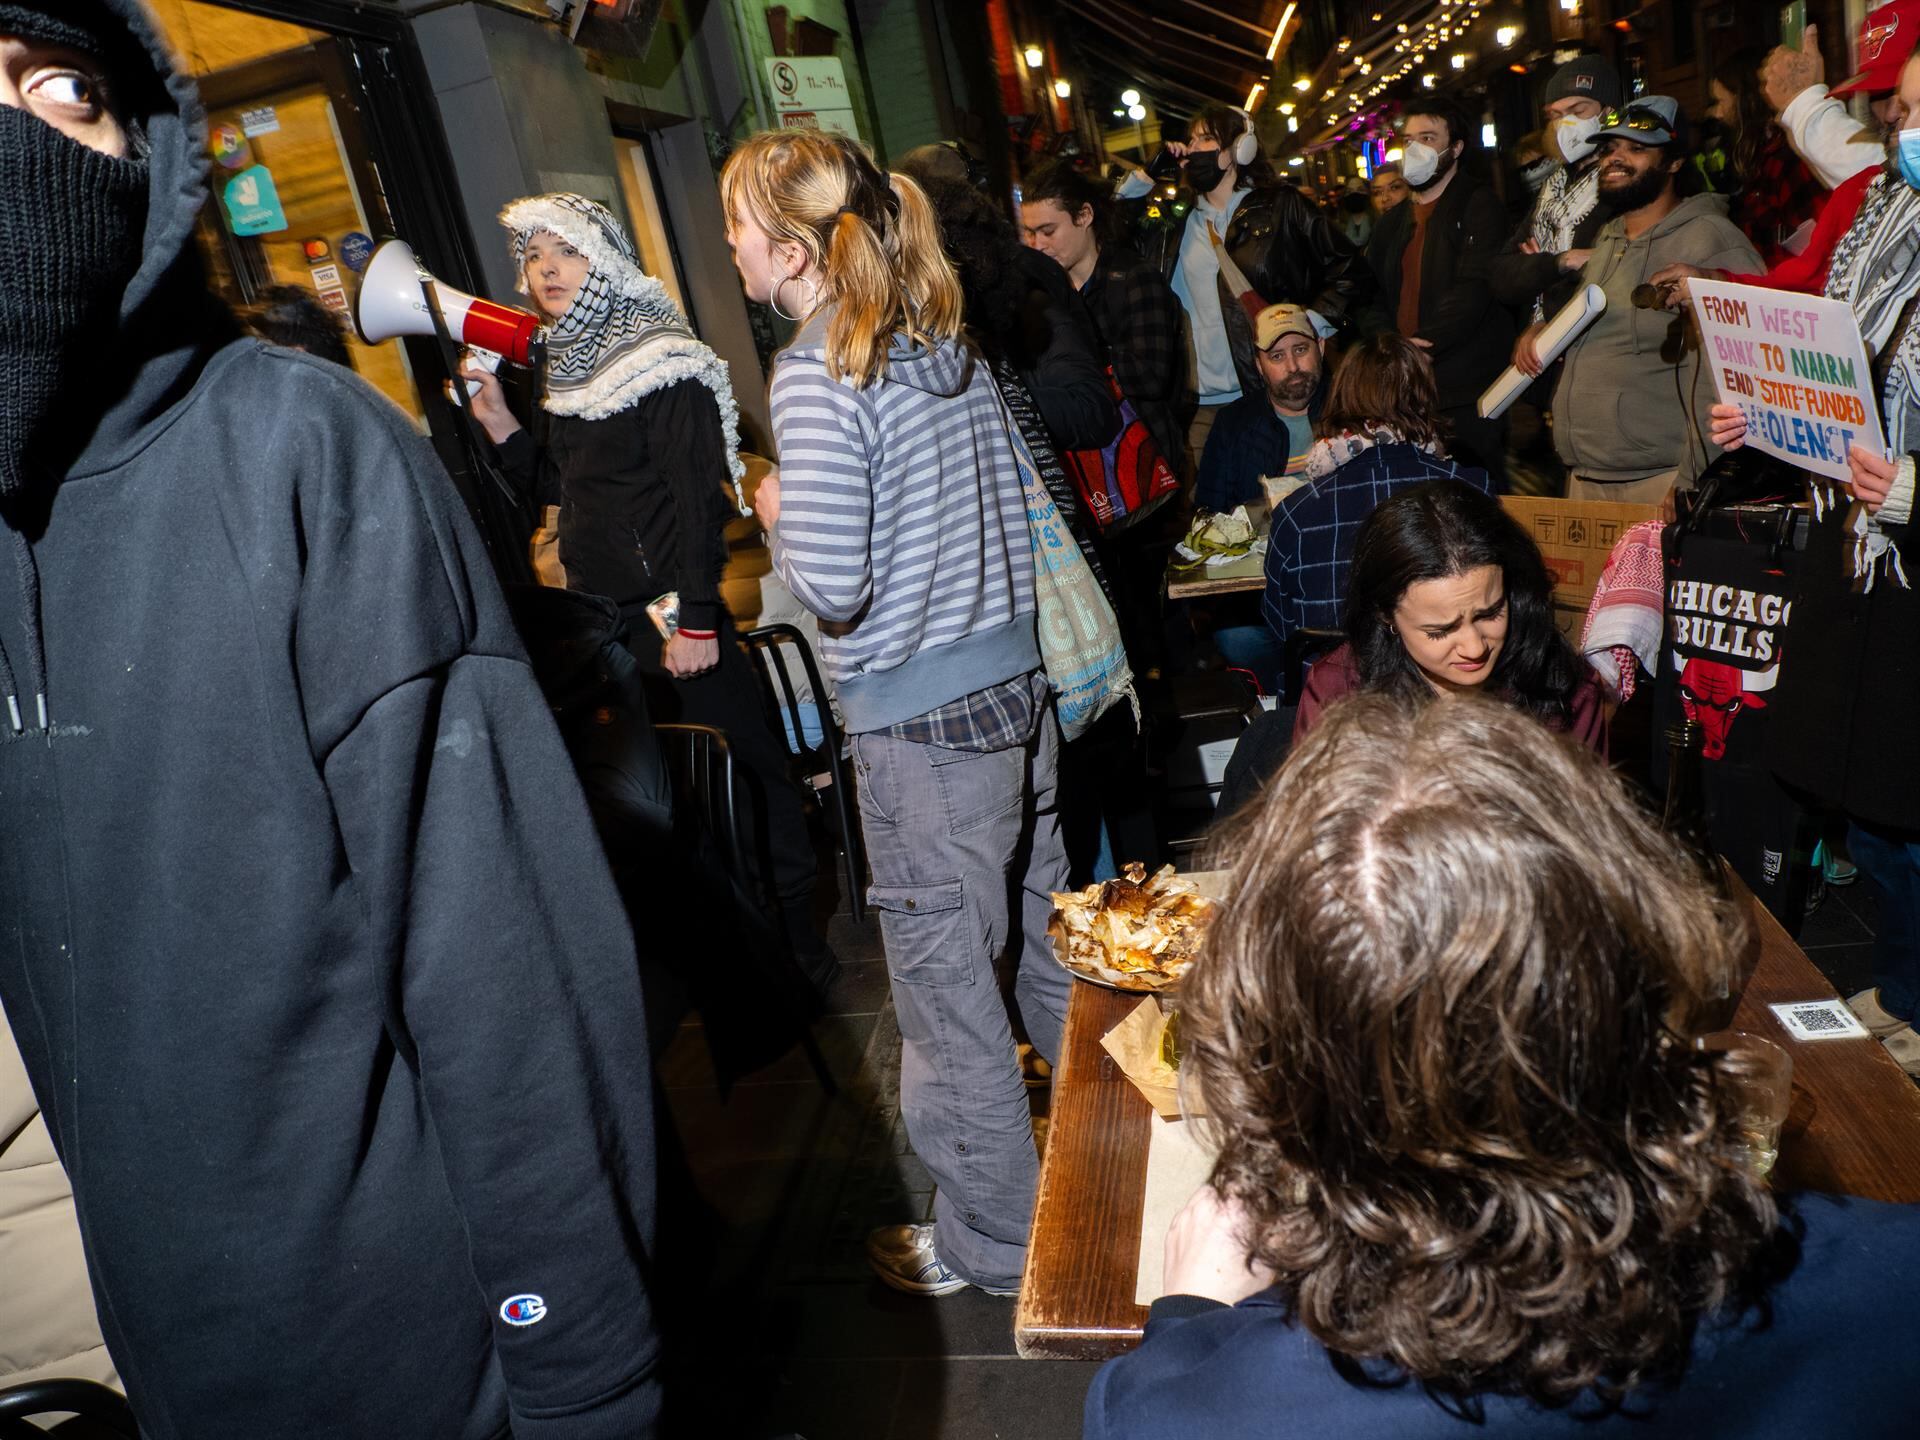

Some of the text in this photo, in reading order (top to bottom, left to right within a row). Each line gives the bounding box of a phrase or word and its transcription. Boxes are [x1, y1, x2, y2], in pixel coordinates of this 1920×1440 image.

[318, 272, 335, 281] VISA
[1702, 296, 1819, 341] FROM WEST
[1714, 335, 1857, 389] BANK TO NAARM
[1723, 368, 1755, 398] END
[1671, 580, 1792, 627] HICAG
[1675, 615, 1775, 661] BULLS
